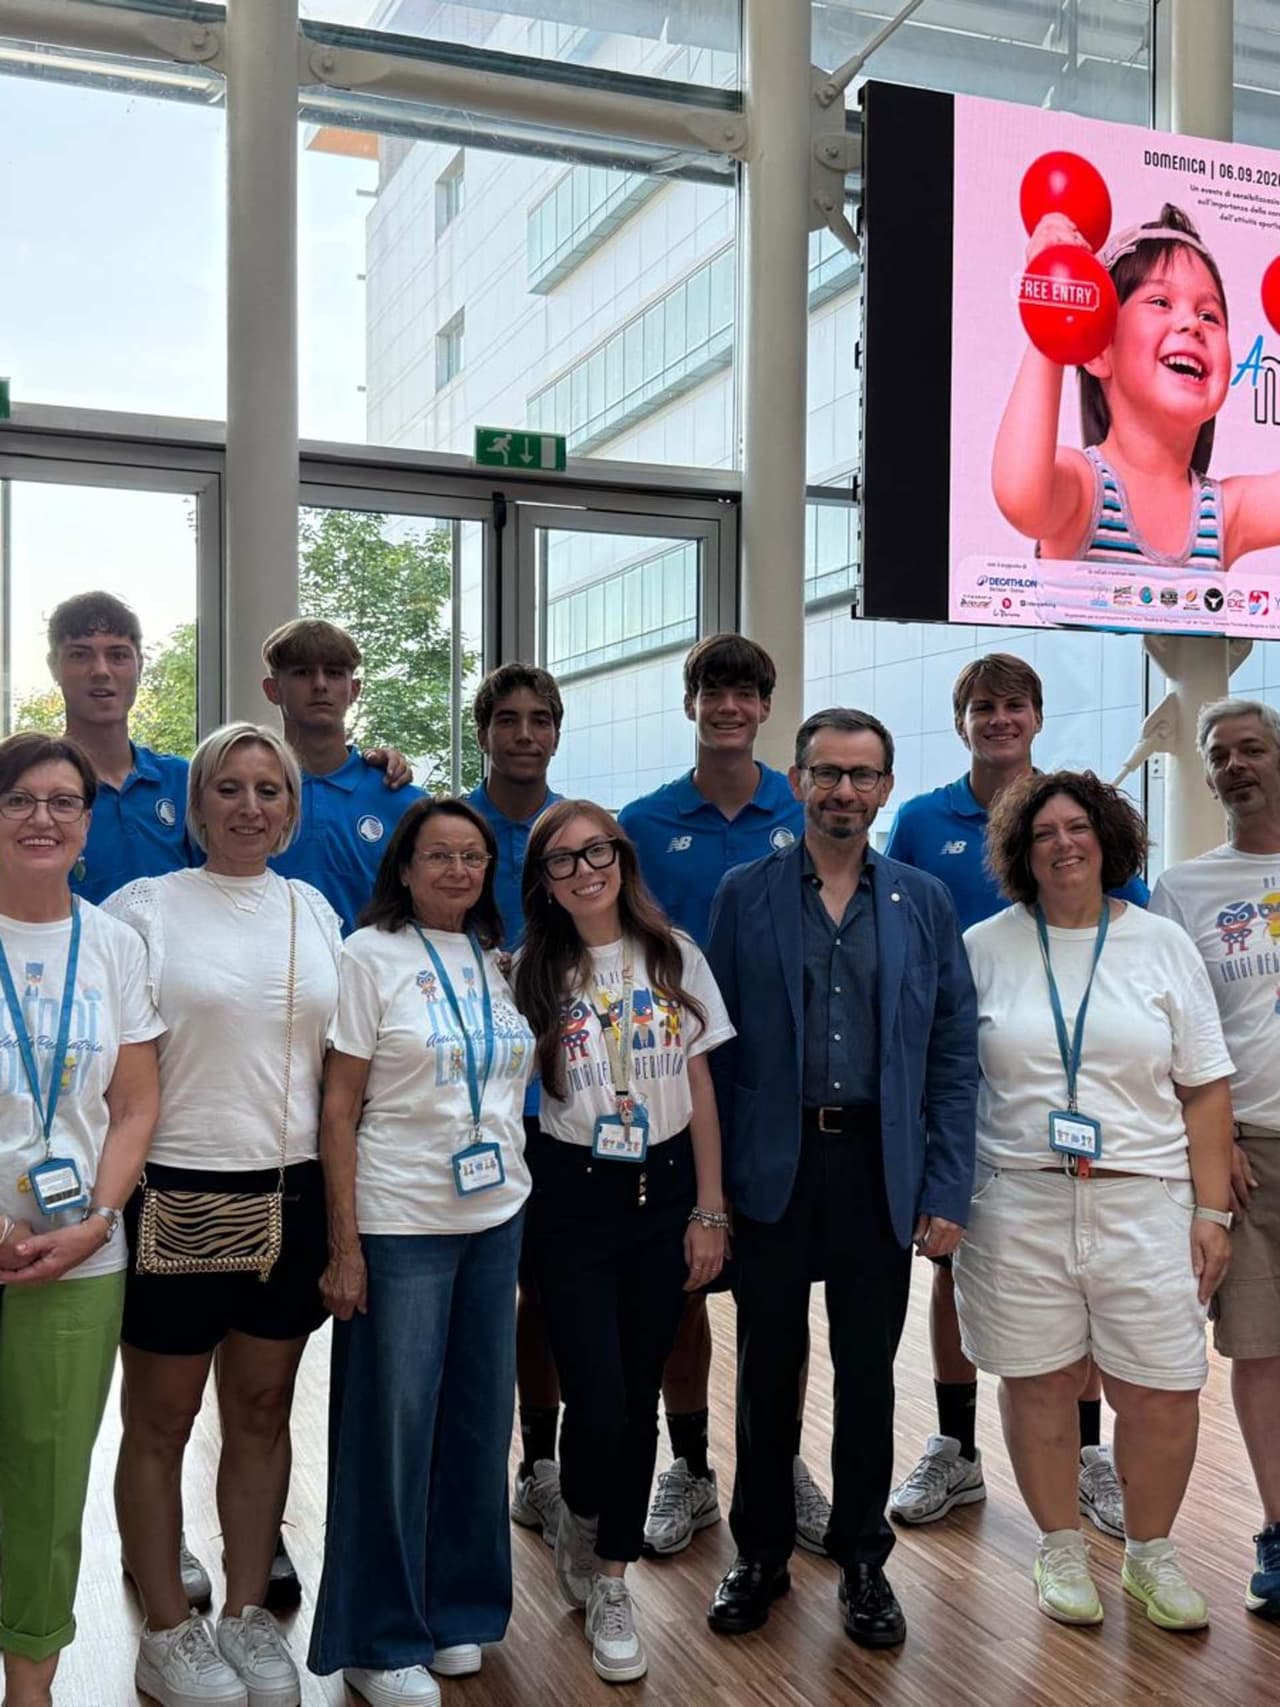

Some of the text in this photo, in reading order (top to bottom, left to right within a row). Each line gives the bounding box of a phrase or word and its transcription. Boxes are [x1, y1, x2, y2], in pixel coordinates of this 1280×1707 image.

[1144, 150, 1206, 175] DOMENICA
[1219, 163, 1280, 187] 06.09.202
[1019, 278, 1093, 305] FREE ENTRY
[989, 577, 1037, 588] DECATHLON
